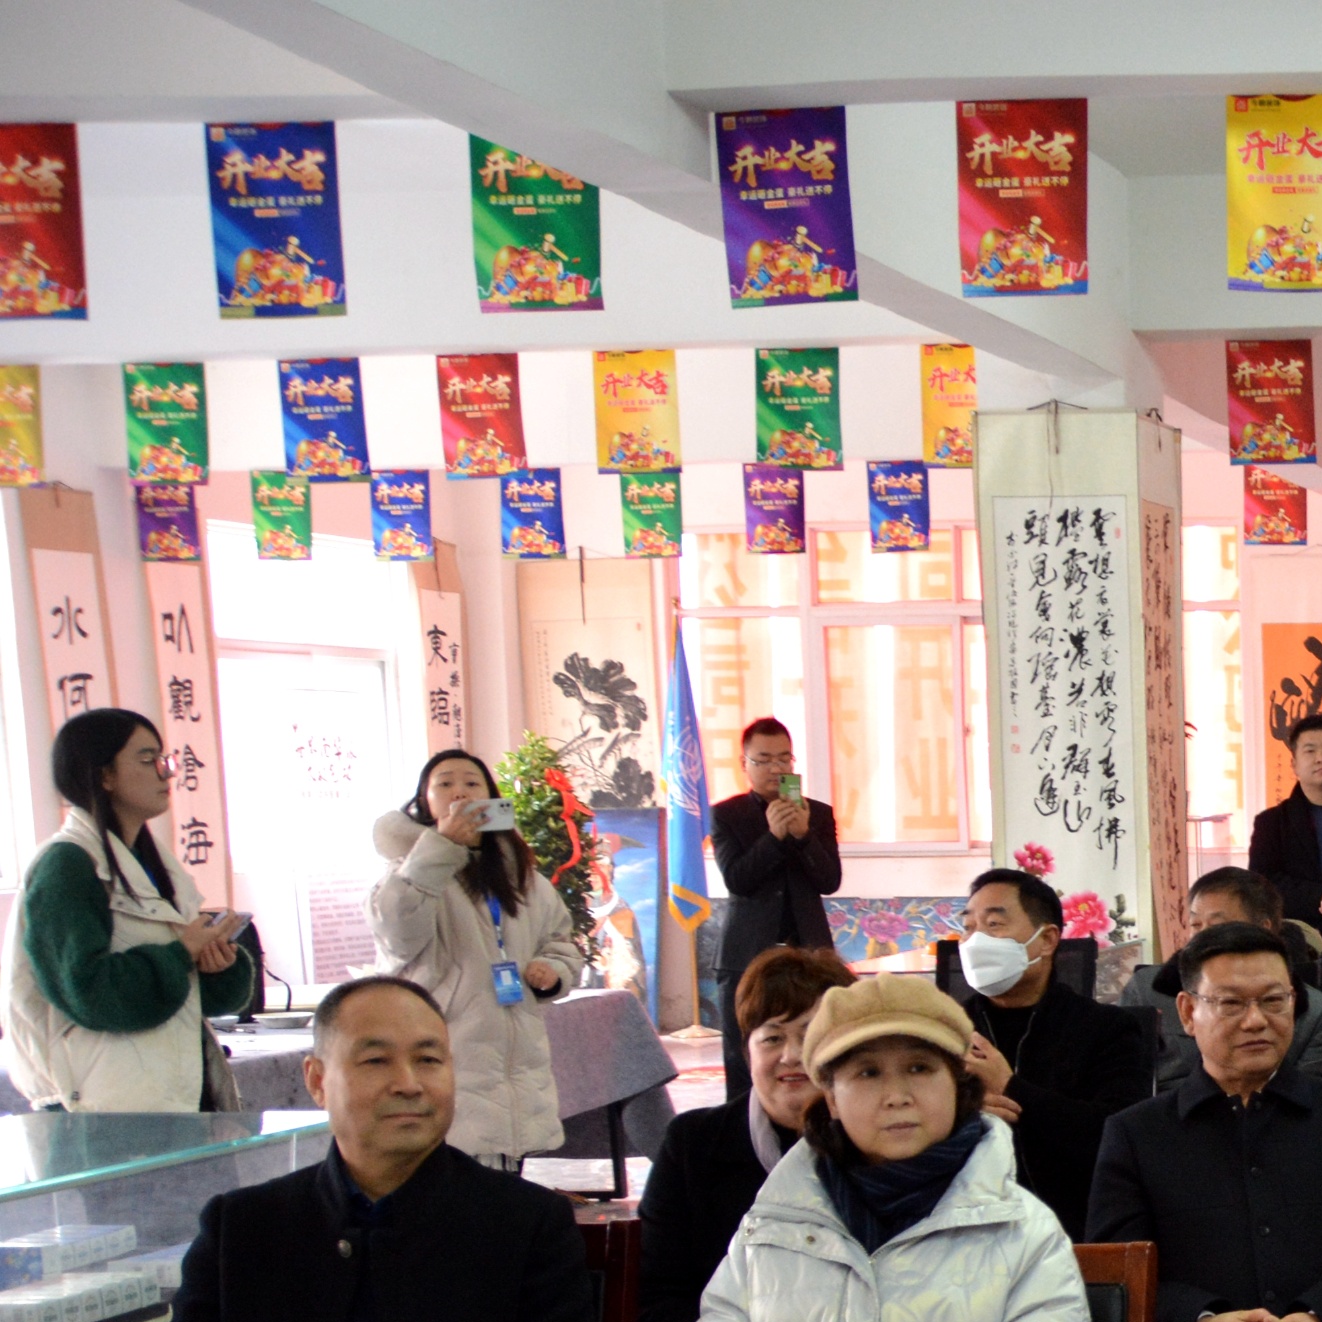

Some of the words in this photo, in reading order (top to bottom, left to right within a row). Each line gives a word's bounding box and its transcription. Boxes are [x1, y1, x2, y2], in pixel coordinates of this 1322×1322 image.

[729, 140, 837, 186] 开业大吉
[968, 130, 1076, 177] 开业大吉
[0, 153, 65, 198] 大吉
[219, 148, 327, 195] 开业大吉
[445, 373, 513, 402] 开业大吉
[601, 369, 670, 398] 开业大吉
[762, 366, 833, 395] 开业大吉
[928, 364, 976, 392] 开业大
[1233, 359, 1306, 388] 开业大吉
[131, 381, 198, 410] 开业大吉
[287, 376, 355, 405] 开业大吉
